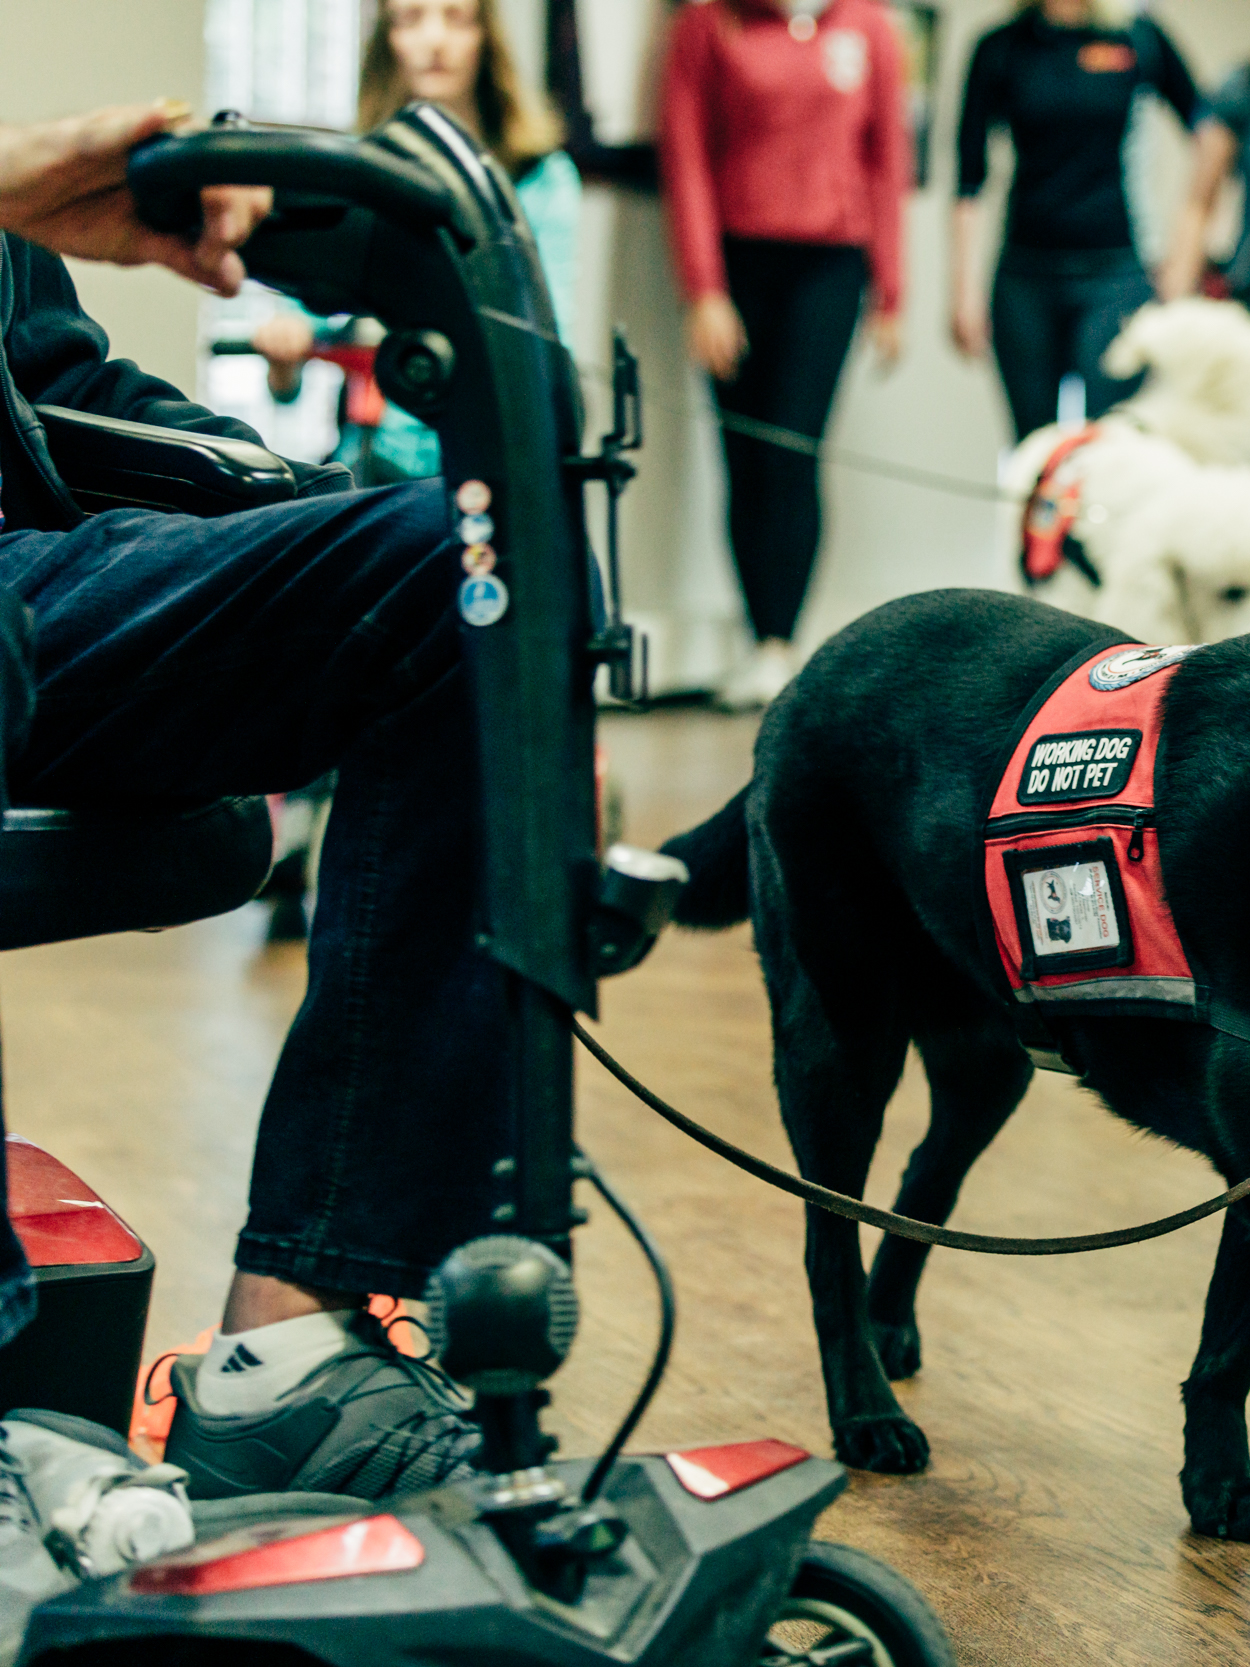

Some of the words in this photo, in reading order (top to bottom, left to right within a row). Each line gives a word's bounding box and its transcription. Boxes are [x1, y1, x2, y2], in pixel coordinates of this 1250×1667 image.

[1031, 738, 1097, 768] WORKING
[1093, 737, 1132, 761] DOG
[1027, 769, 1050, 794] DO
[1051, 764, 1085, 792] NOT
[1083, 762, 1118, 788] PET
[1092, 865, 1105, 911] SERVICE
[1100, 914, 1110, 938] DOG
